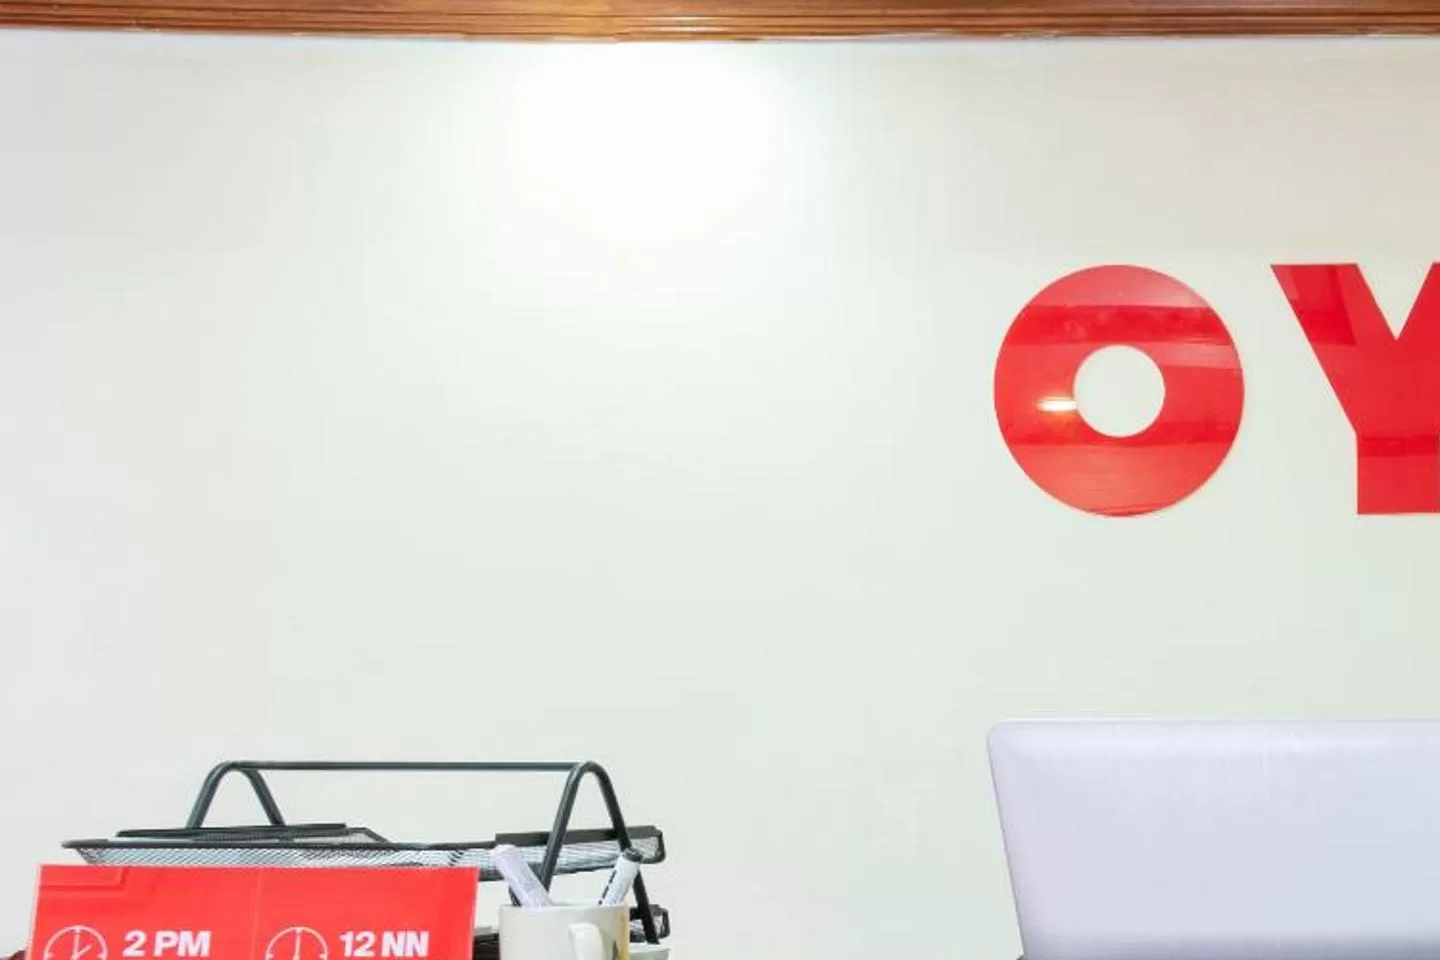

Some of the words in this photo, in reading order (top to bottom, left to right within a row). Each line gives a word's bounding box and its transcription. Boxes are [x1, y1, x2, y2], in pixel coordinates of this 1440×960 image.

[122, 930, 148, 957] 2
[153, 930, 212, 957] PM
[339, 931, 374, 958] 12
[380, 931, 430, 958] NN
